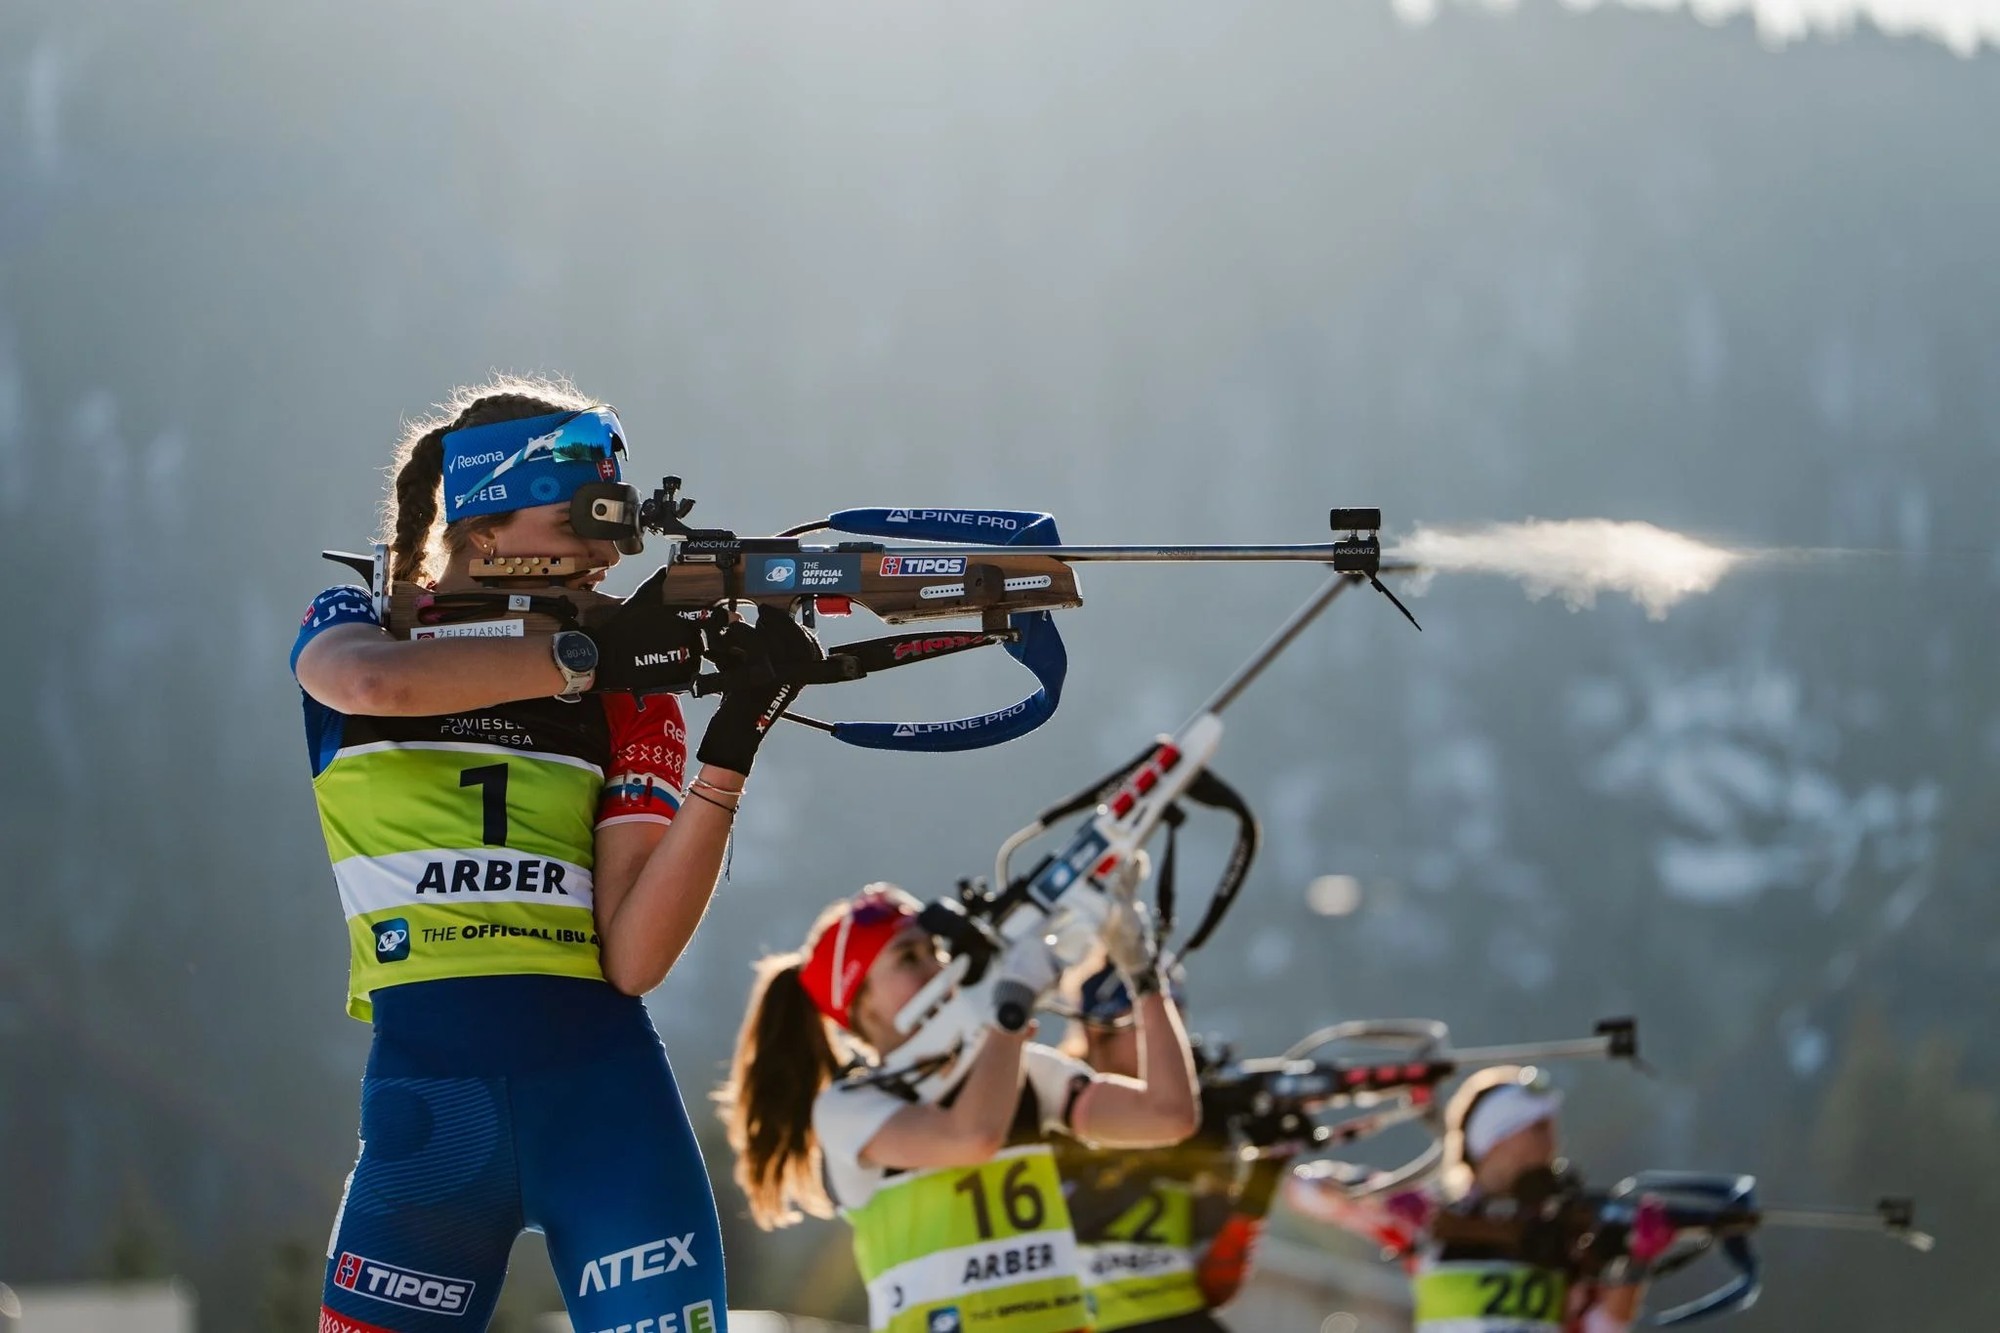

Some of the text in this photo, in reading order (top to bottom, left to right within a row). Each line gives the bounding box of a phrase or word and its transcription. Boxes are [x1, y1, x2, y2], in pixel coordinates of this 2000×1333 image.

[457, 450, 504, 469] Rexona
[886, 509, 1017, 531] ALPINE PRO
[802, 569, 843, 578] OFFICIAL
[802, 577, 839, 585] IBU APP
[904, 559, 962, 573] TIPOS
[893, 702, 1026, 737] ALPINE PRO
[459, 762, 509, 848] 1
[416, 859, 569, 895] ARBER
[422, 926, 457, 943] THE
[462, 924, 553, 940] OFFICIAL
[556, 929, 587, 944] IBU
[954, 1158, 1046, 1240] 16
[578, 1232, 698, 1298] ATEX
[961, 1244, 1056, 1284] ARBER
[366, 1266, 466, 1309] TIPOS
[1477, 1270, 1552, 1319] 20
